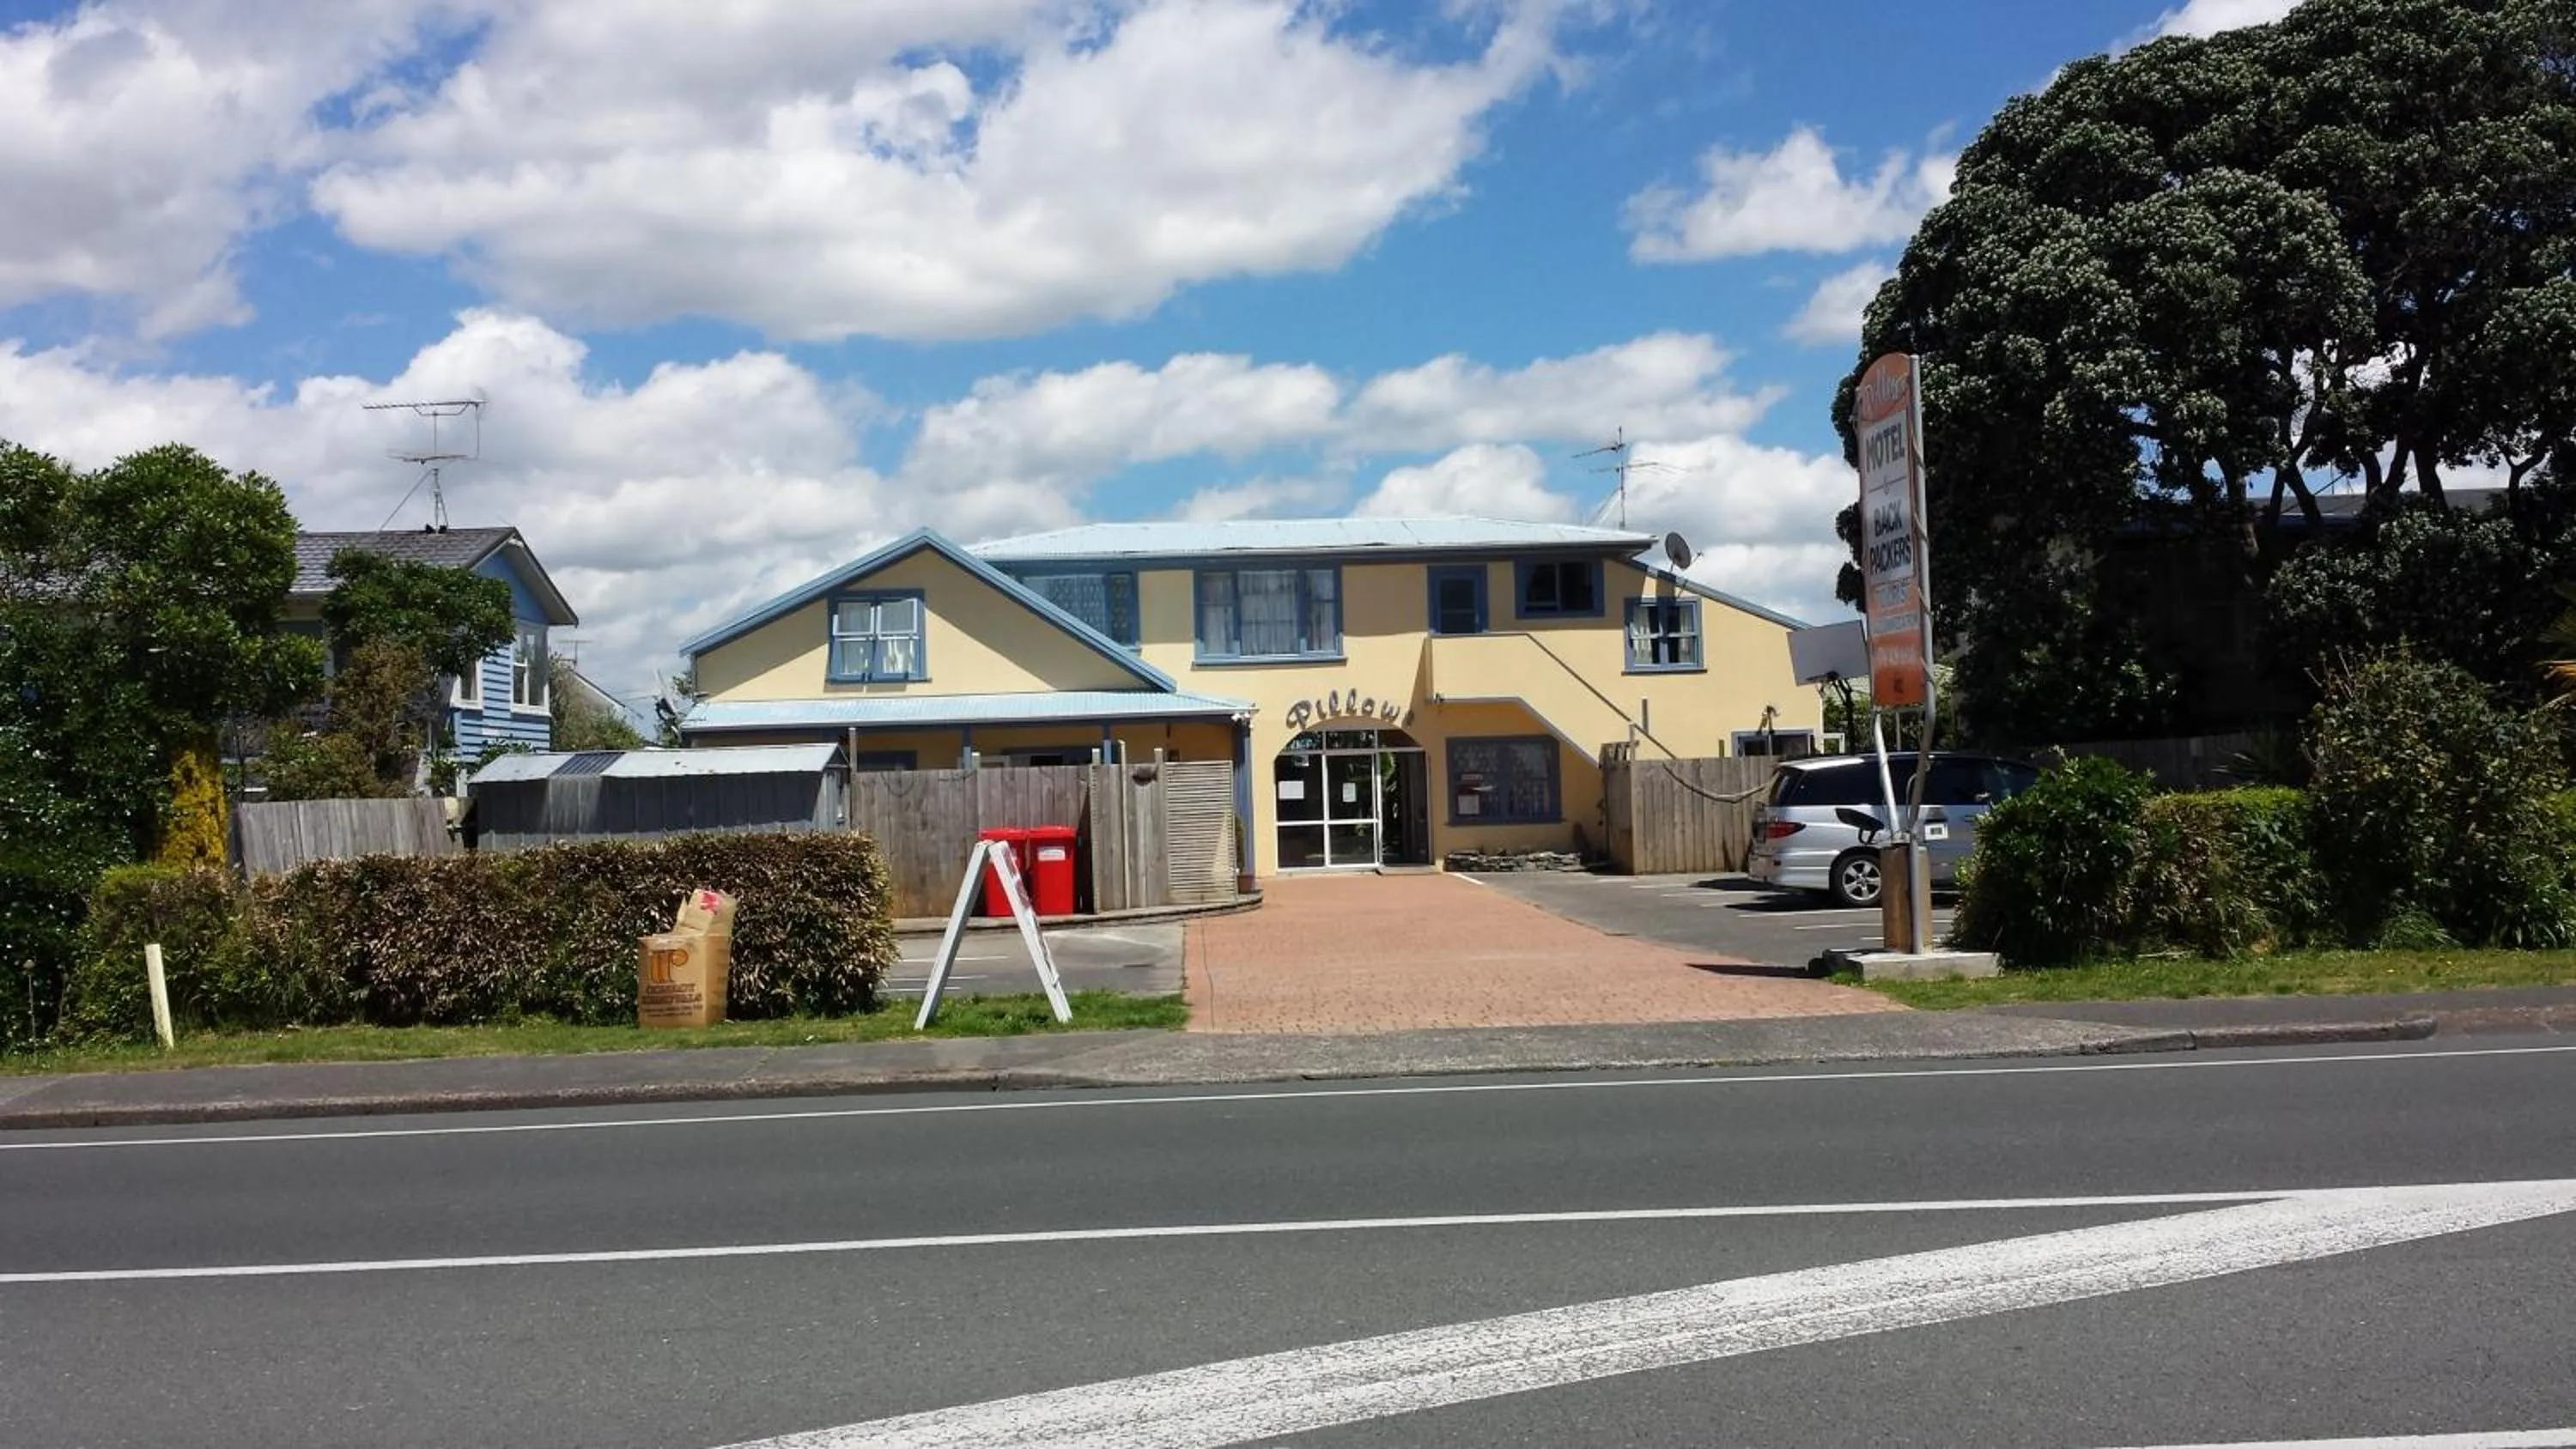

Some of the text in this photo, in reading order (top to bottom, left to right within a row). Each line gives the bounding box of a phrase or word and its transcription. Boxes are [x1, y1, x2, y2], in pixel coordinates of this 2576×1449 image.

[1865, 422, 1905, 472] MOTEL
[1874, 500, 1902, 537] BACK
[1870, 534, 1911, 576] PACKERS
